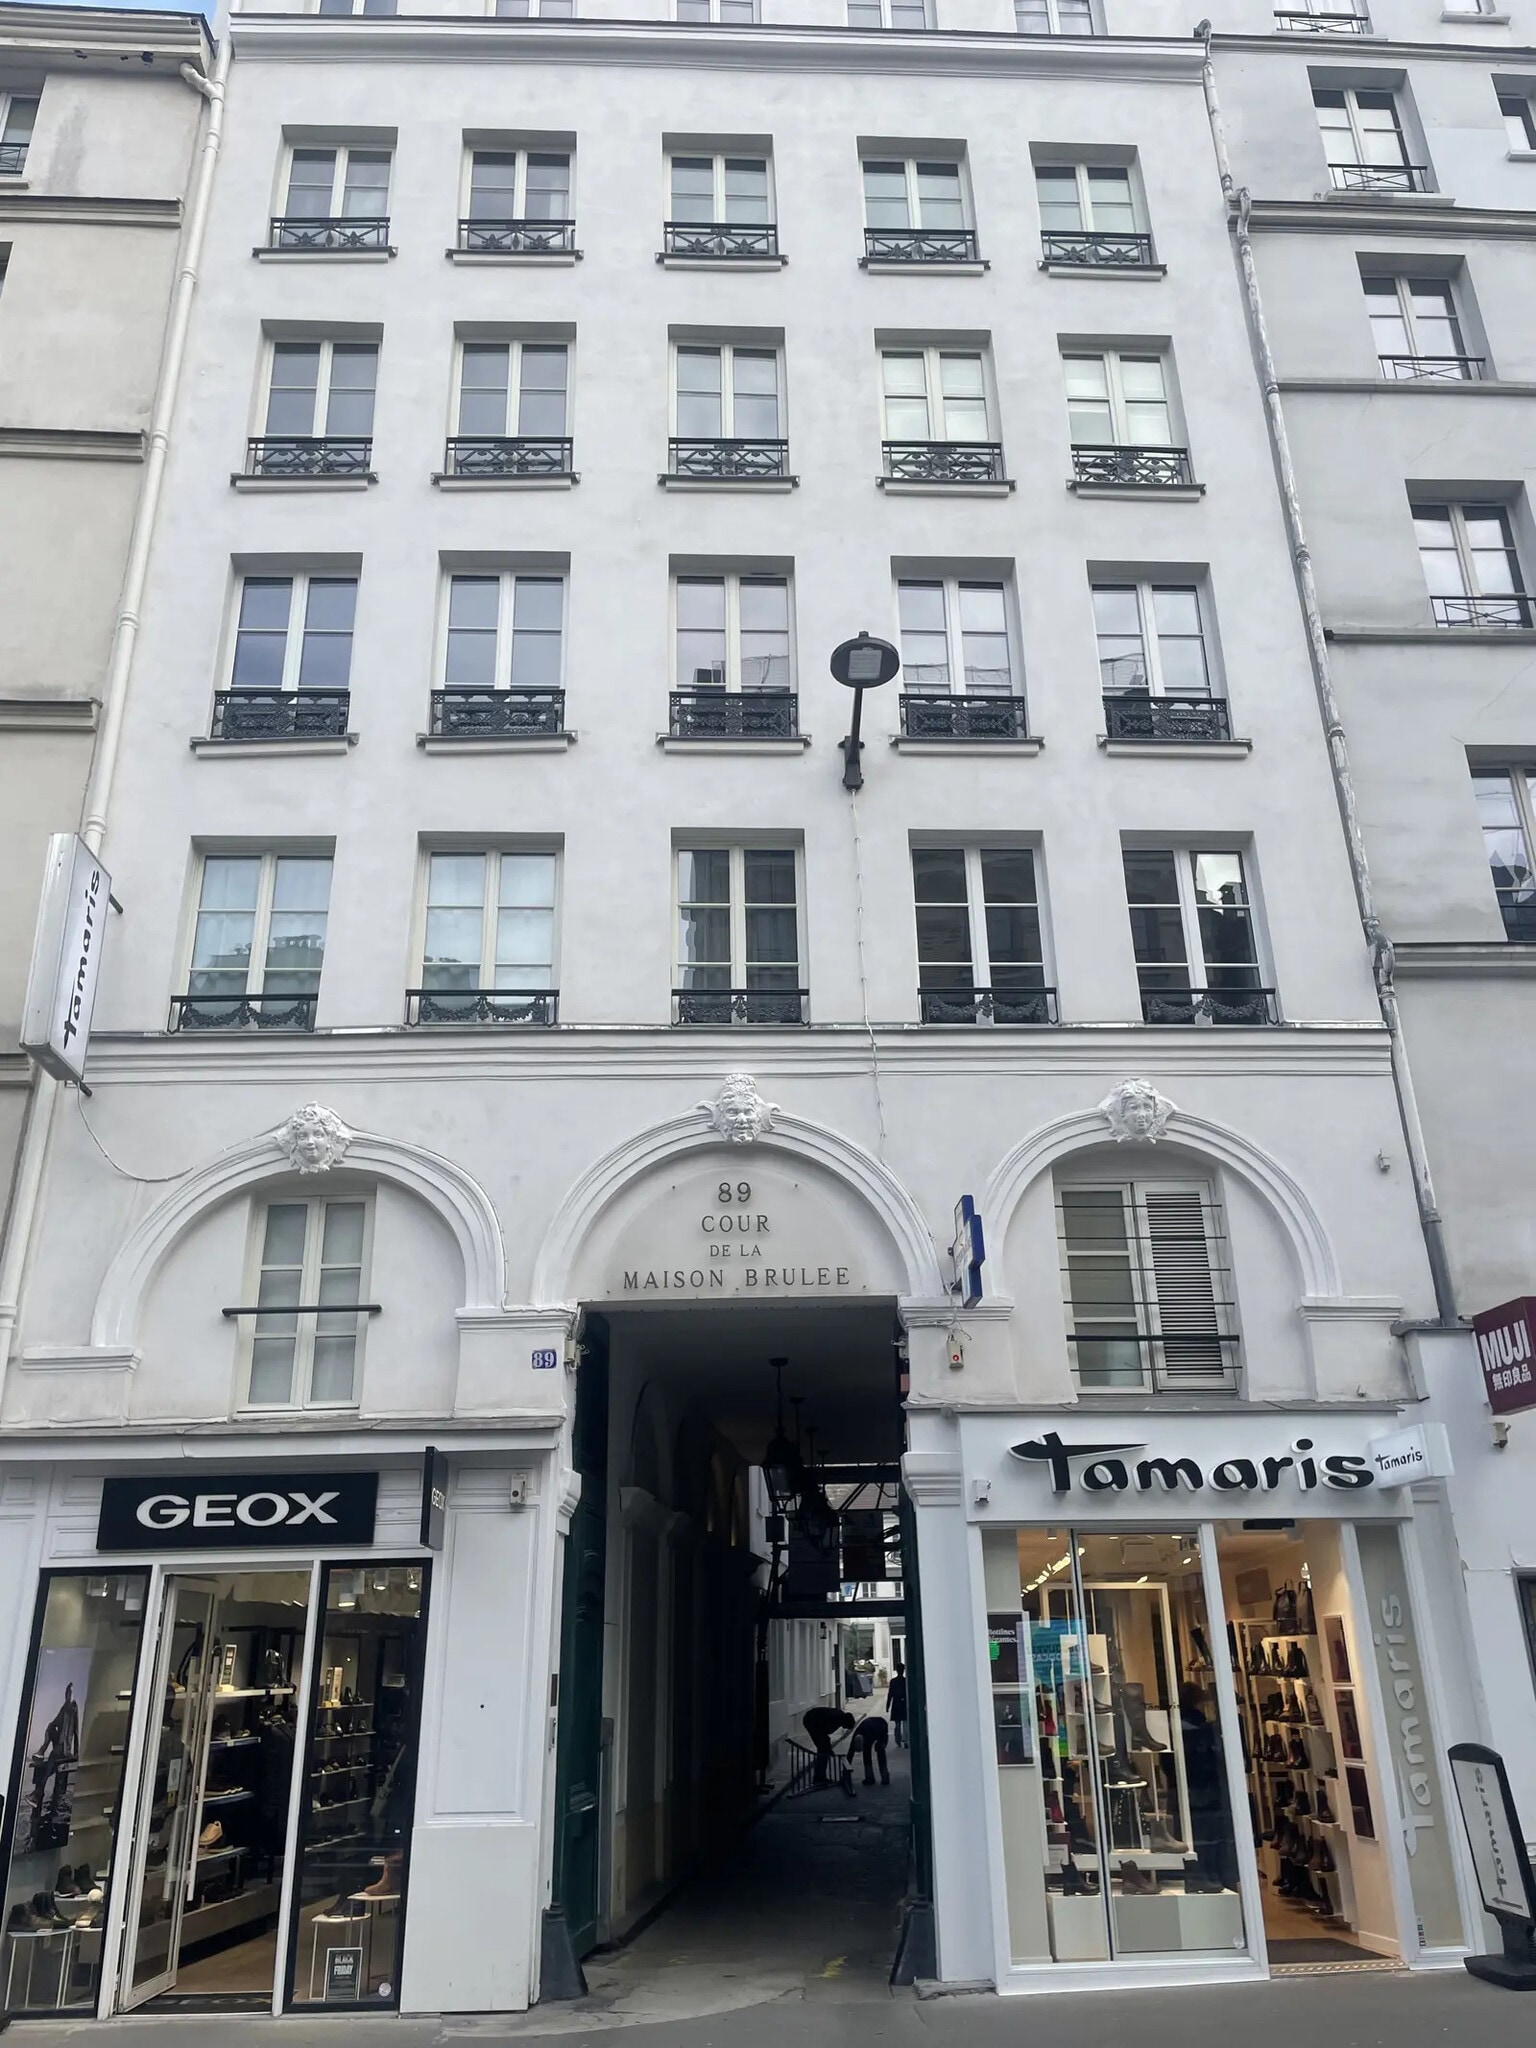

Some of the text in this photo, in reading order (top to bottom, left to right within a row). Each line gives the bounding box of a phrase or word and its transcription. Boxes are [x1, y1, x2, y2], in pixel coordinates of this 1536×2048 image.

[63, 870, 100, 1050] Tamaris
[717, 1181, 752, 1203] 89
[701, 1214, 770, 1233] COUR
[709, 1244, 762, 1257] DE LA
[623, 1267, 850, 1290] MAISON BRULEE
[1479, 1319, 1532, 1372] MUJI
[533, 1351, 555, 1368] 89
[1492, 1363, 1532, 1392] 無印良品
[1008, 1431, 1375, 1494] Tamaris
[1374, 1446, 1423, 1471] Tamaris
[136, 1491, 341, 1529] GEOX
[1373, 1594, 1435, 1857] Tamaris
[334, 1965, 354, 1975] FRIDAY
[335, 1954, 354, 1964] BLACK
